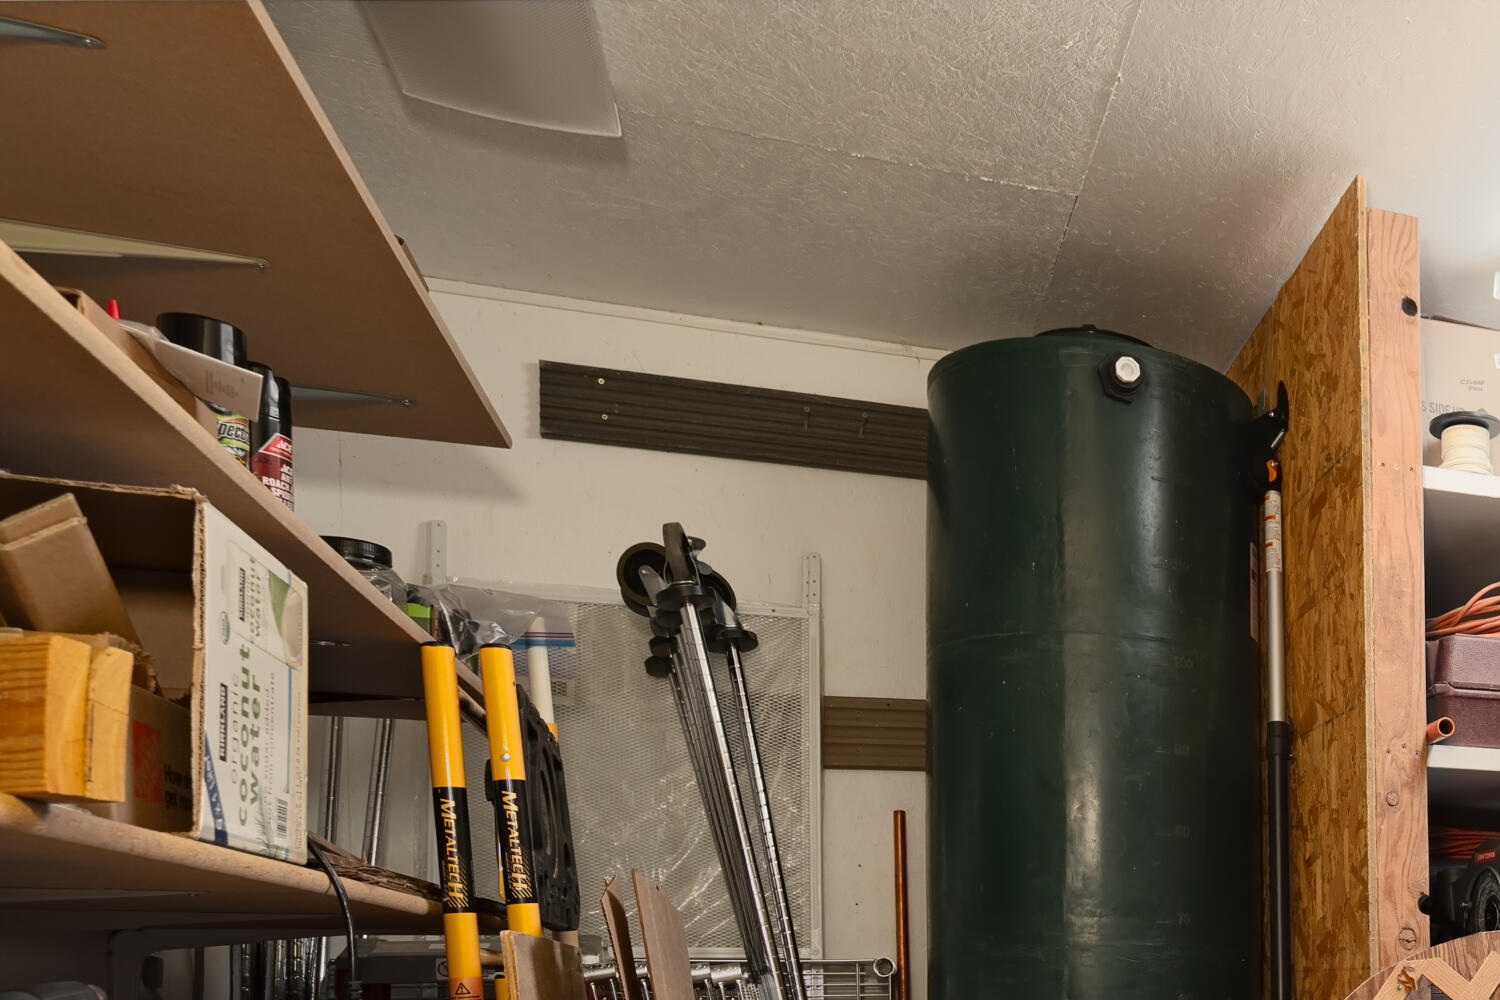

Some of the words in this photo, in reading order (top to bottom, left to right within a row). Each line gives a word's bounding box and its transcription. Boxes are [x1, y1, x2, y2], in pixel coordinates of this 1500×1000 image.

[219, 683, 228, 762] KIRKLAND
[231, 672, 240, 785] organic
[239, 644, 251, 826] coconut
[250, 674, 261, 805] water
[440, 798, 465, 899] METALTECH
[501, 790, 528, 891] METALTECH
